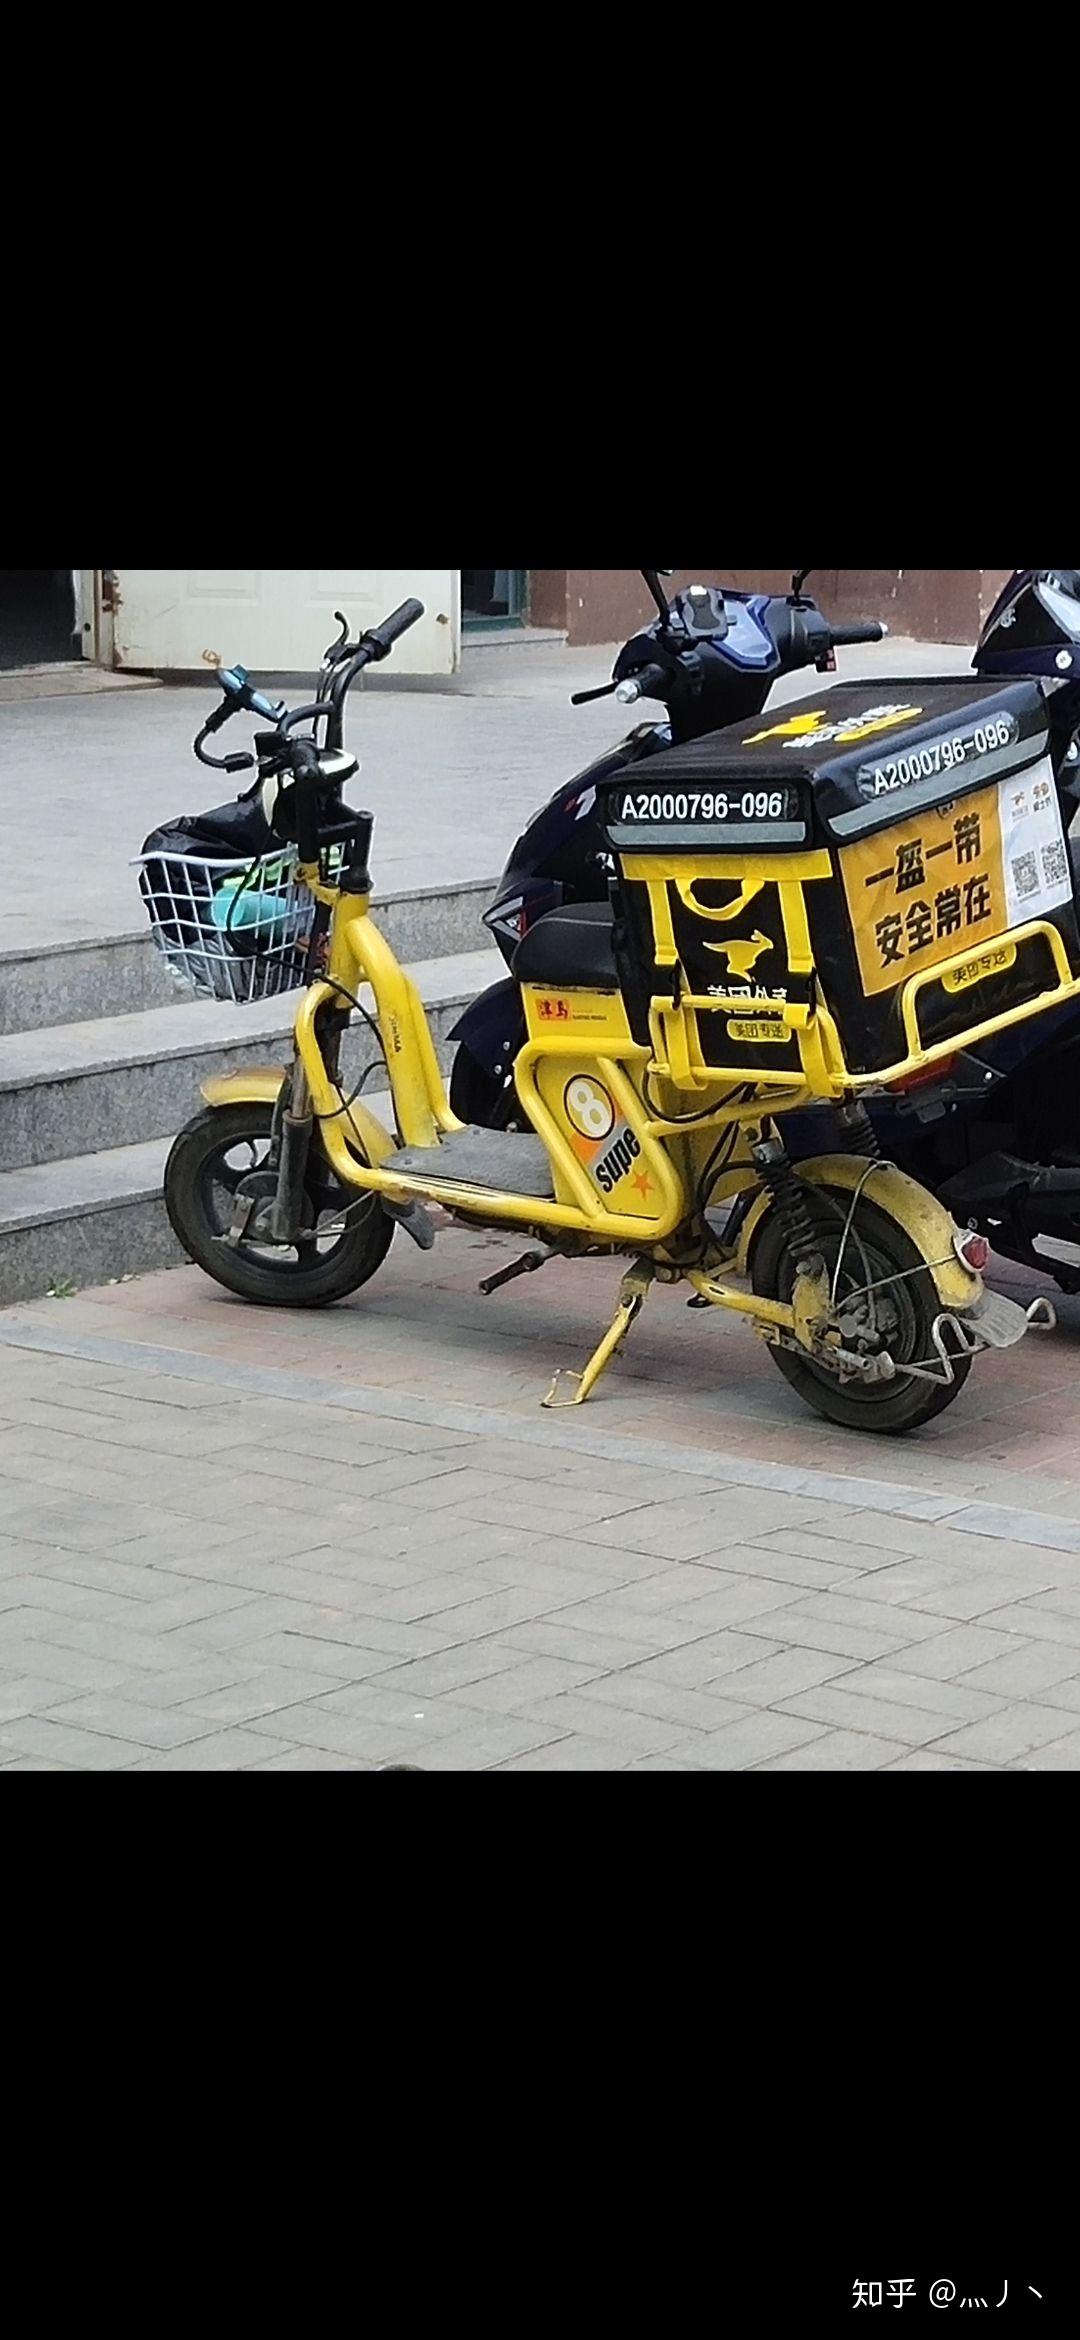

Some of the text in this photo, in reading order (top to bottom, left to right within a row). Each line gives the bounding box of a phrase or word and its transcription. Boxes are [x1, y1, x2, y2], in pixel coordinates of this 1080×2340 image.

[874, 719, 1011, 795] A2000796-096
[621, 792, 783, 820] A2000796-096
[864, 811, 982, 895] 一盔一带
[874, 872, 992, 969] 安全常在
[569, 1081, 612, 1135] 8
